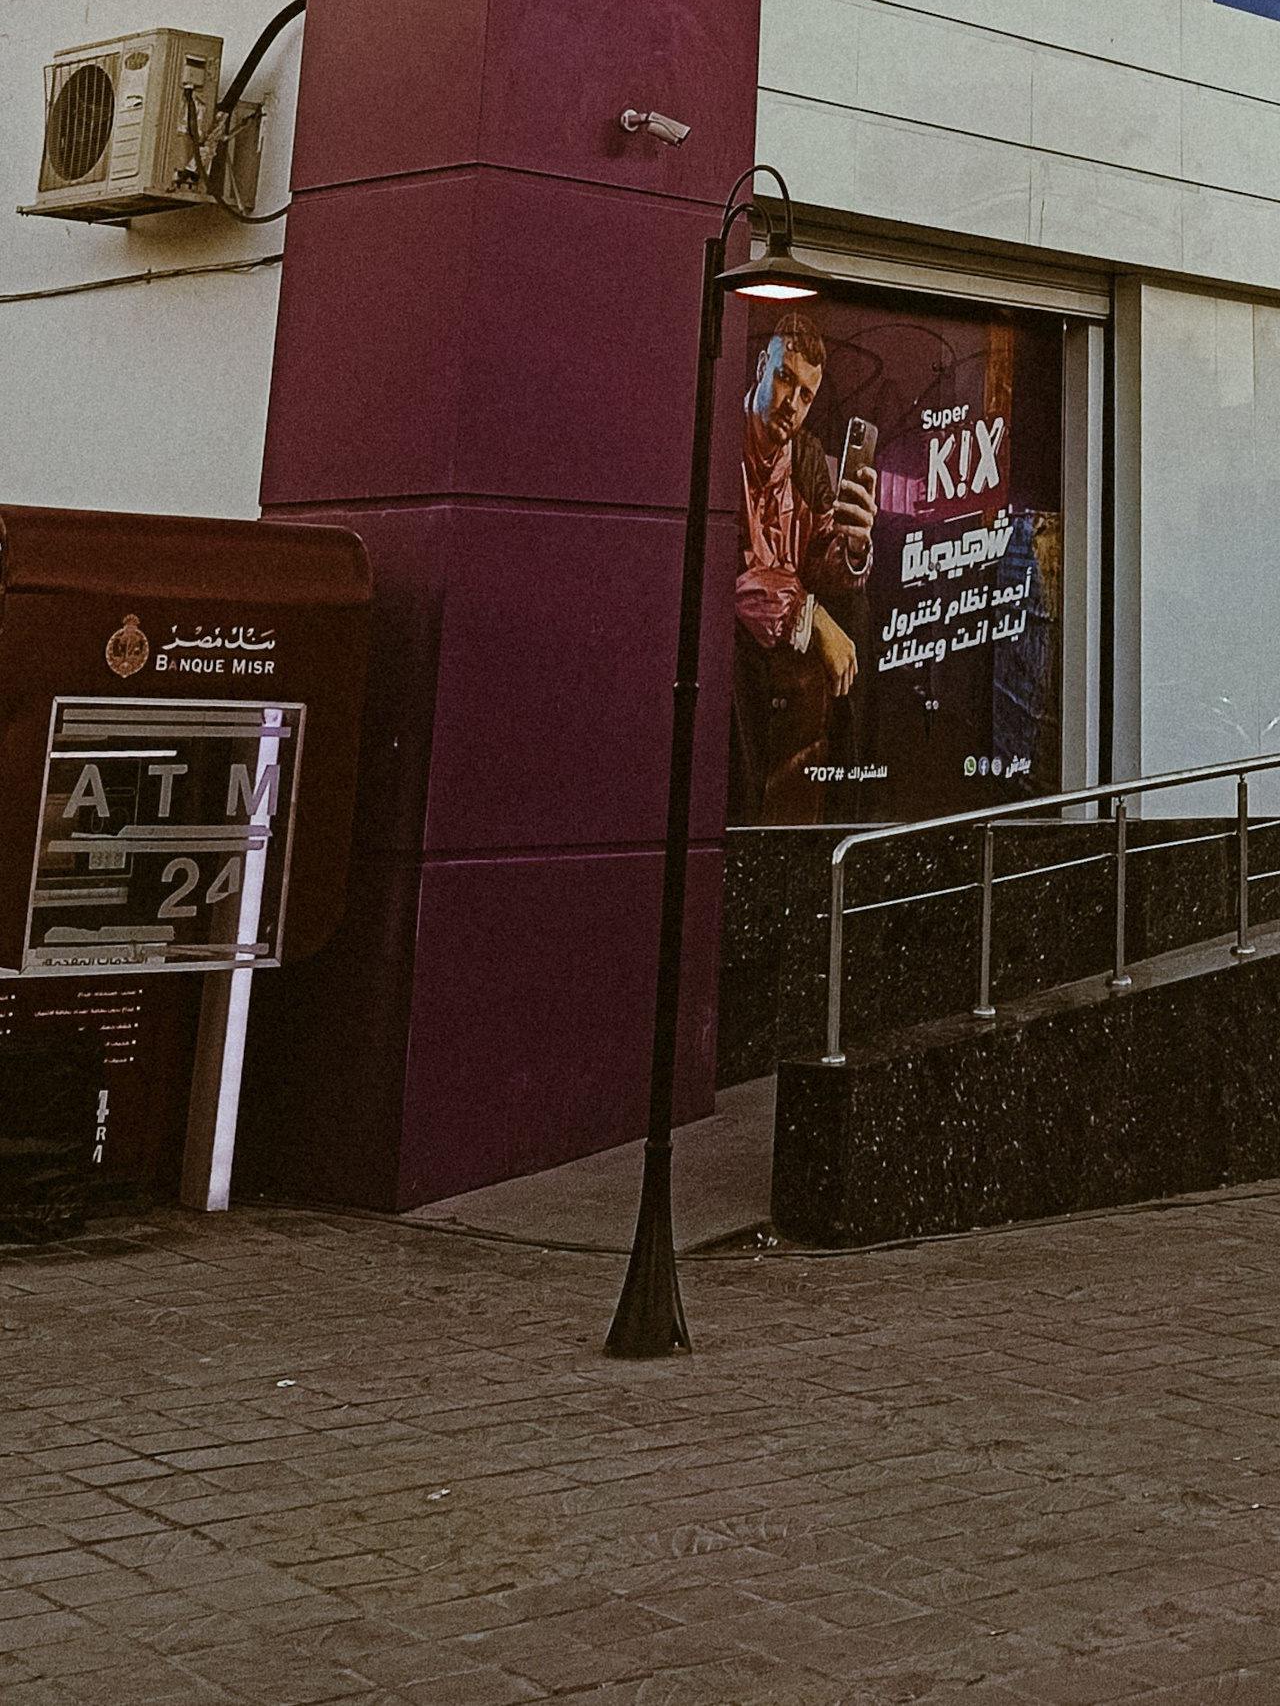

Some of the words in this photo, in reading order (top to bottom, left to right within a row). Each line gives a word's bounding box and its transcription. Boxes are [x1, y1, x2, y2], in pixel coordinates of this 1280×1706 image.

[921, 403, 969, 430] Super
[944, 585, 989, 625] نظام
[991, 566, 1032, 607] أجمد
[882, 597, 942, 642] كنترول
[951, 619, 989, 651] انت
[991, 609, 1027, 642] ليك
[878, 637, 947, 673] وعيلتك
[157, 856, 242, 919] 24
